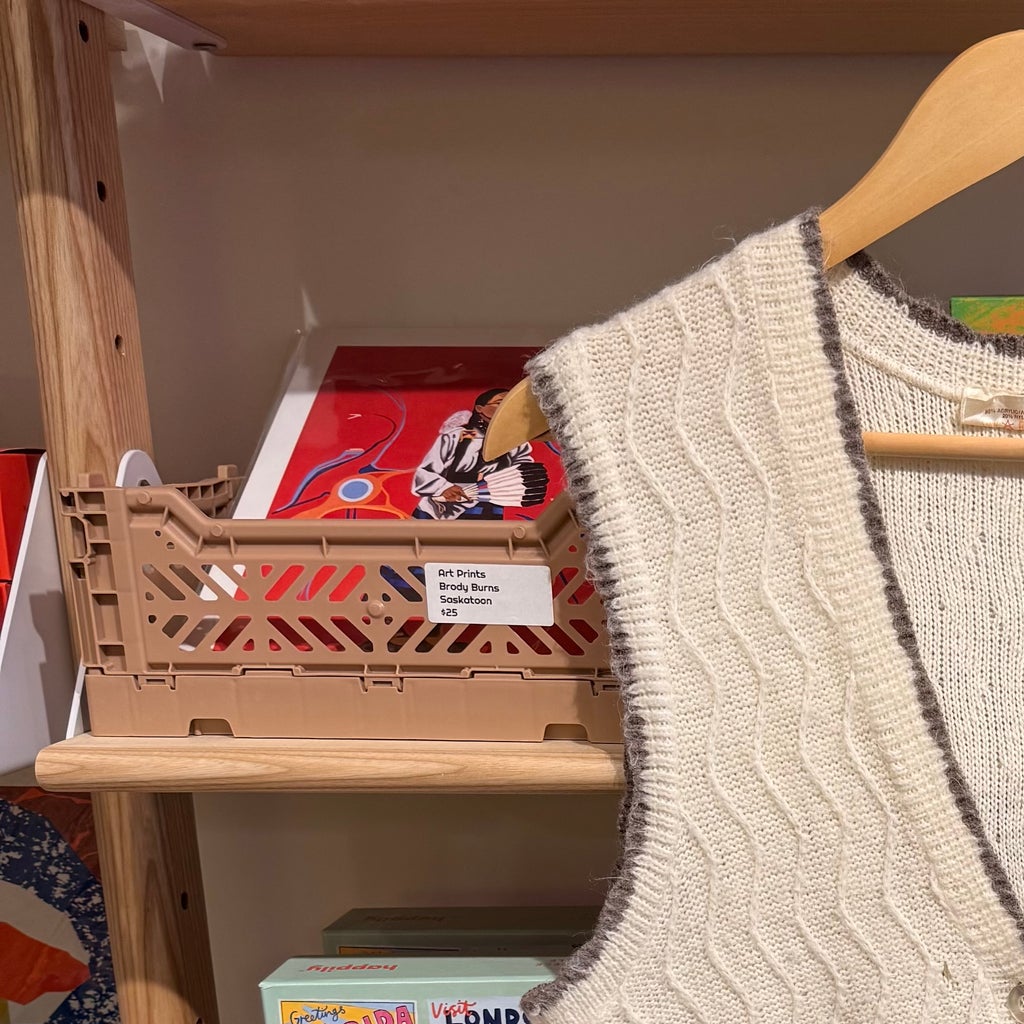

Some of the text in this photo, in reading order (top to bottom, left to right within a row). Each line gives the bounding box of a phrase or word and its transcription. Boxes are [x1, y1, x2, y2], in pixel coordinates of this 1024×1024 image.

[438, 569, 486, 579] Art Prints
[439, 582, 500, 593] Brody Burns
[440, 595, 493, 605] Saskatoon
[440, 608, 458, 617] $25
[431, 1000, 477, 1020] Visit
